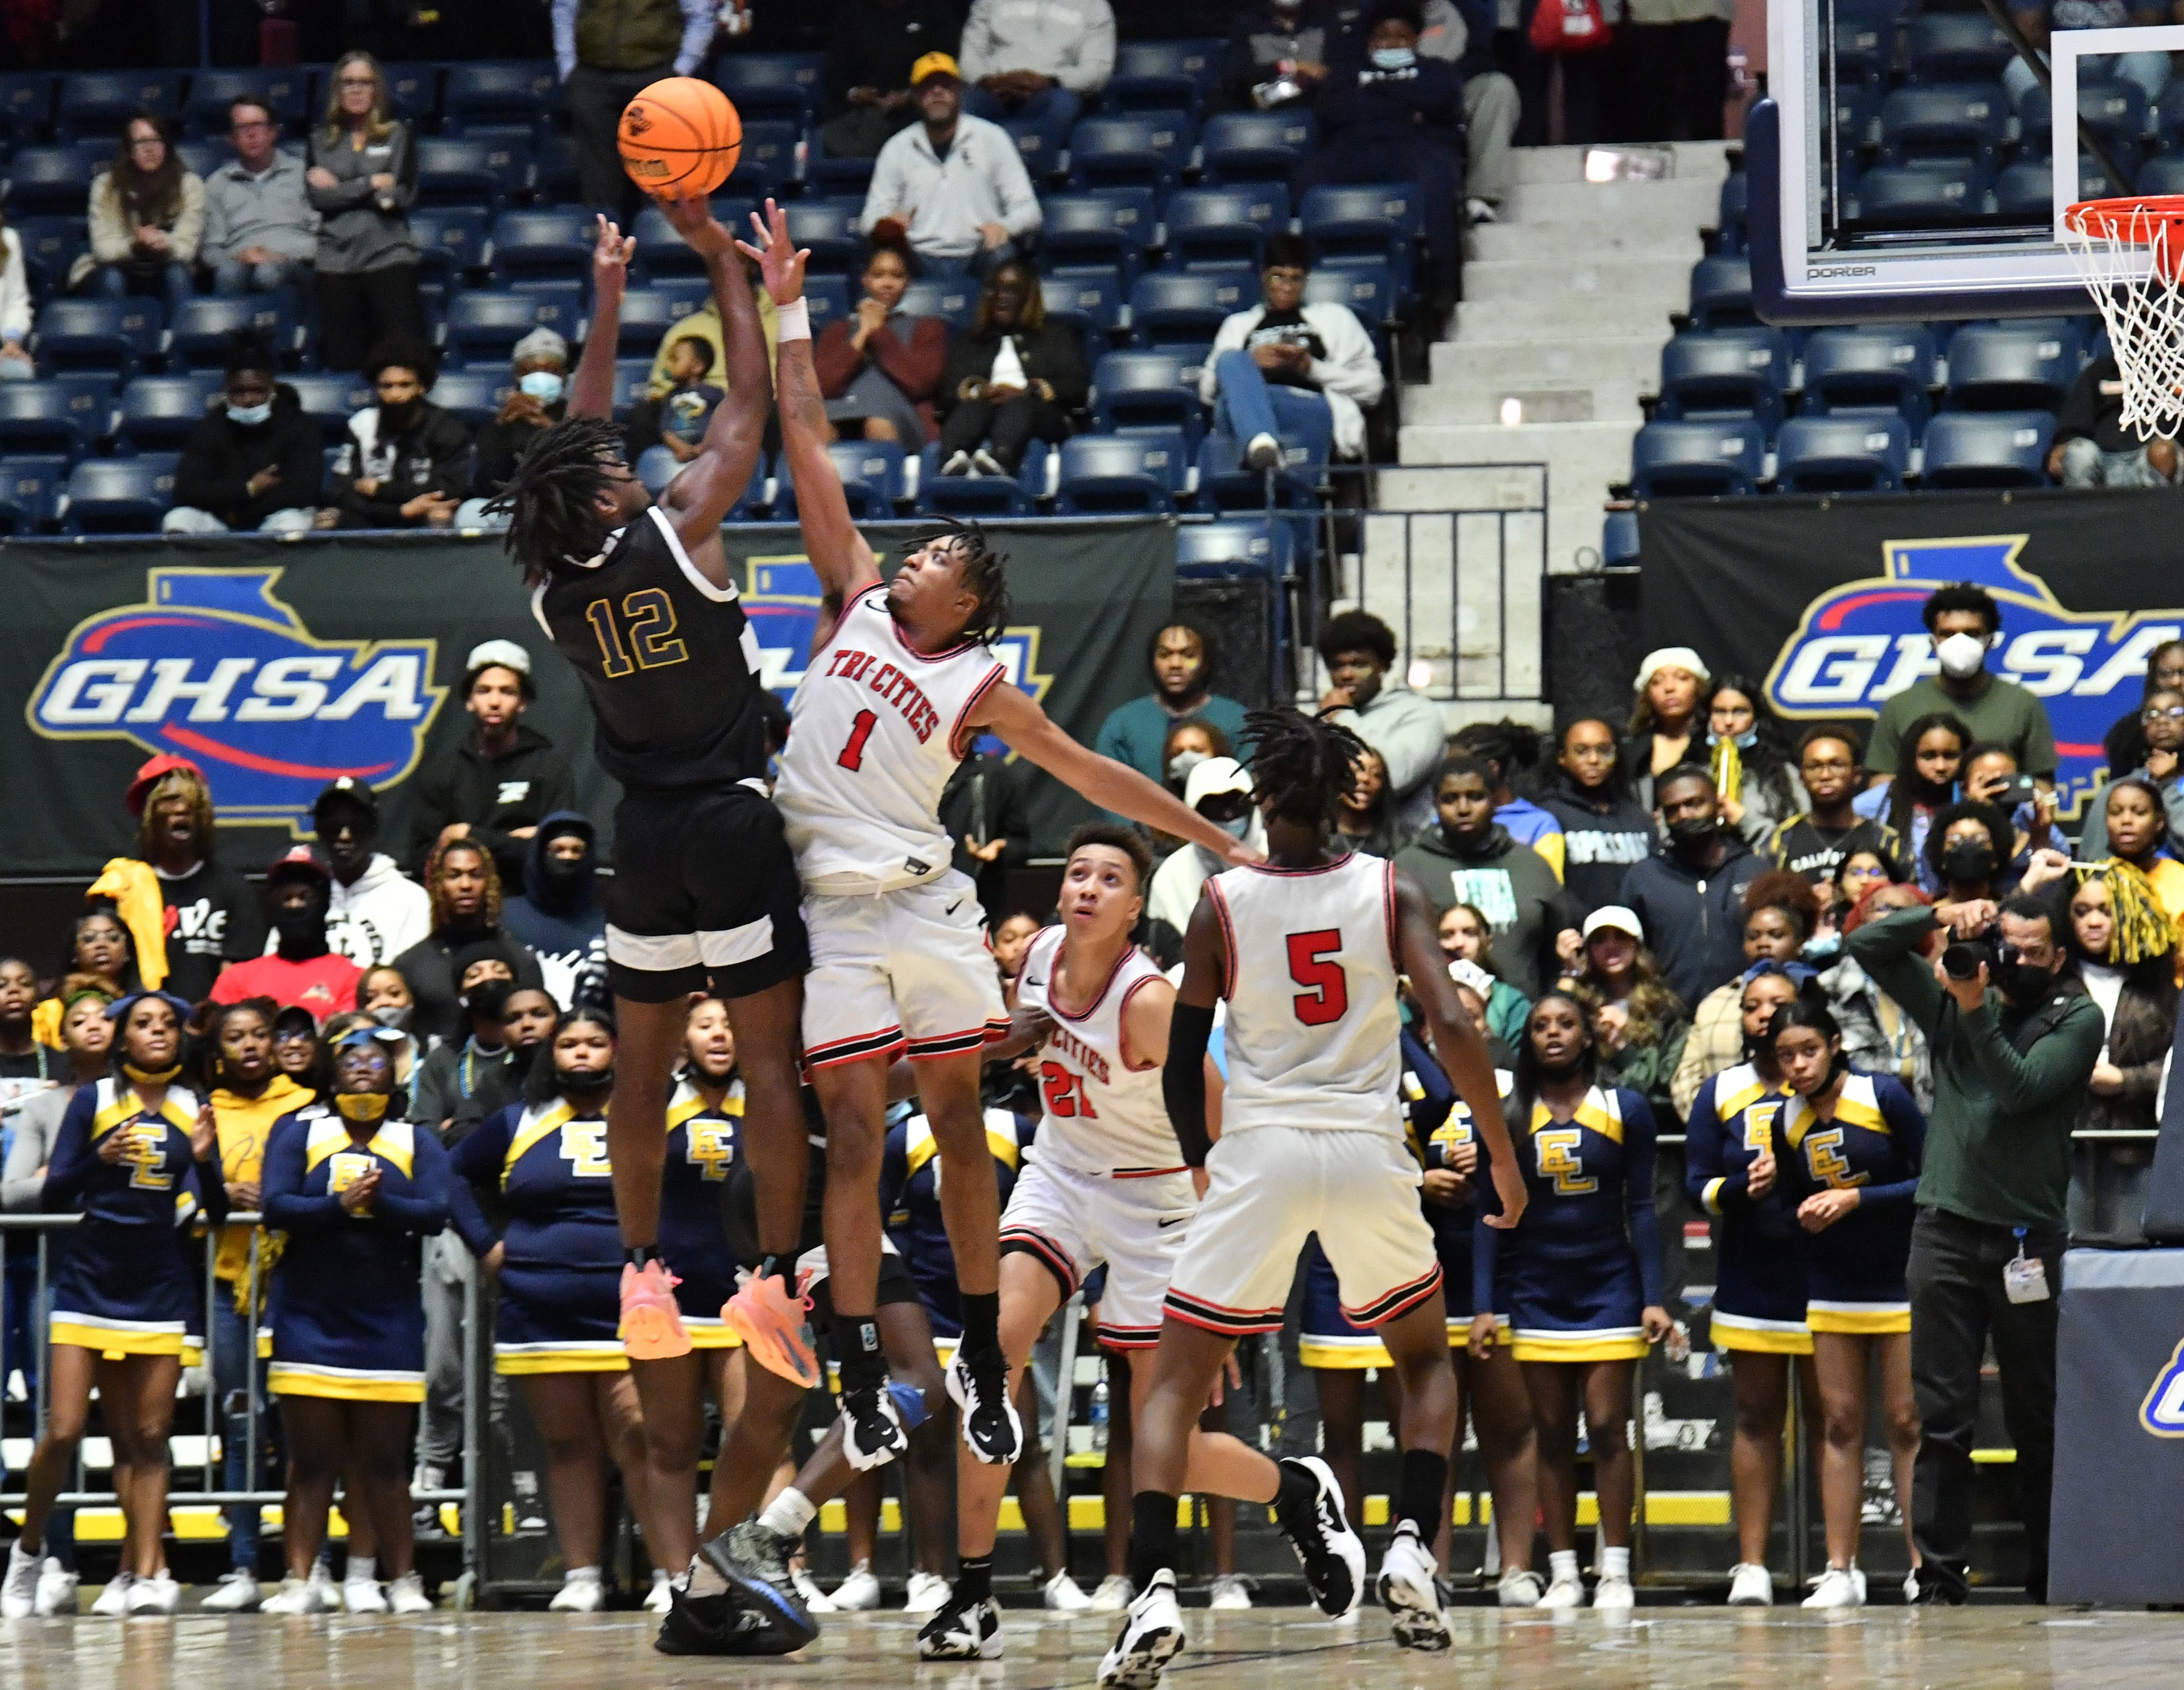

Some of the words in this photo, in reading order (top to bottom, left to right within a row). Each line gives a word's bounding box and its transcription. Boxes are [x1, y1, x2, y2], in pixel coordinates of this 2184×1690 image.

[586, 587, 689, 678] 12
[40, 655, 424, 724] GHSA
[825, 649, 940, 745] TRI-CITIES
[837, 708, 879, 772] 1
[1790, 847, 1847, 873] CALIFO
[1285, 927, 1349, 1026] 5
[1041, 1060, 1098, 1119] 21
